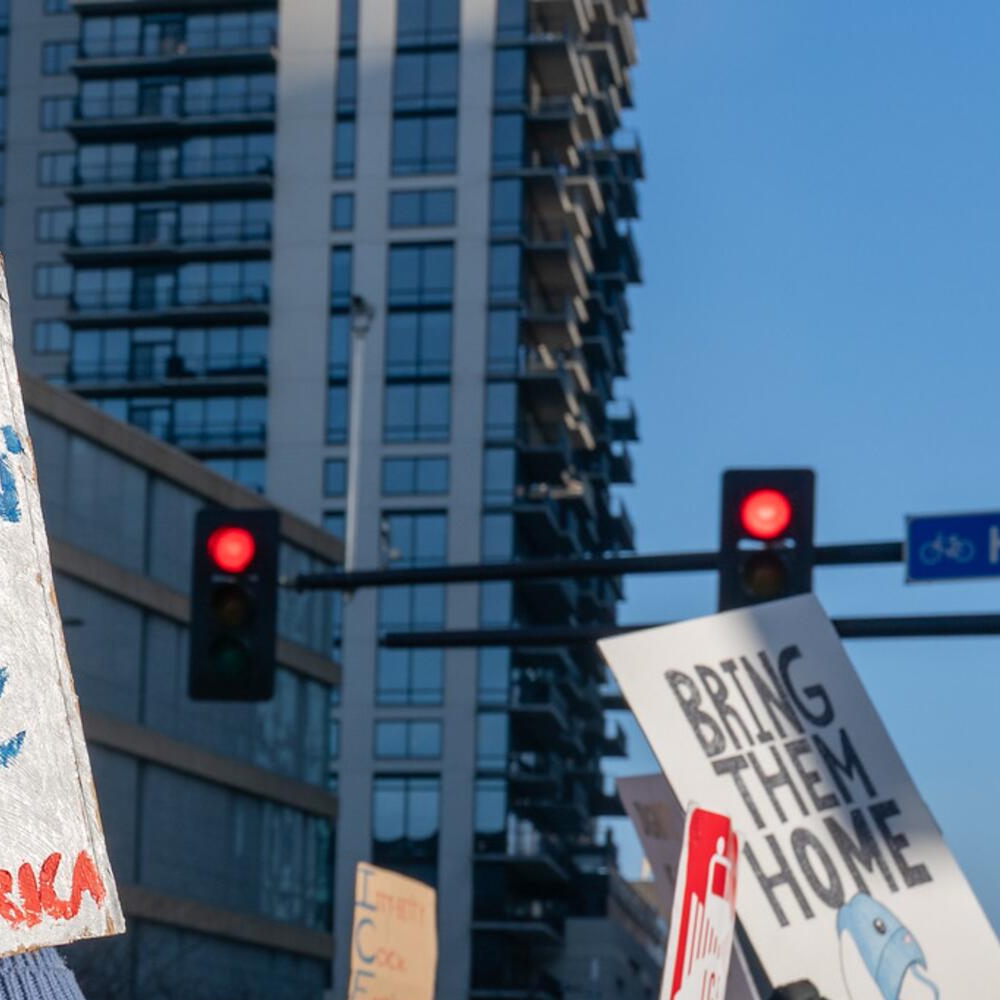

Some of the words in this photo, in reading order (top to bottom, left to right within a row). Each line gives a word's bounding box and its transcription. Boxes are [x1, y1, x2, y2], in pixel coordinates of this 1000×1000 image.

[664, 645, 835, 758] BRING
[711, 728, 877, 831] THEM
[743, 799, 933, 928] HOME
